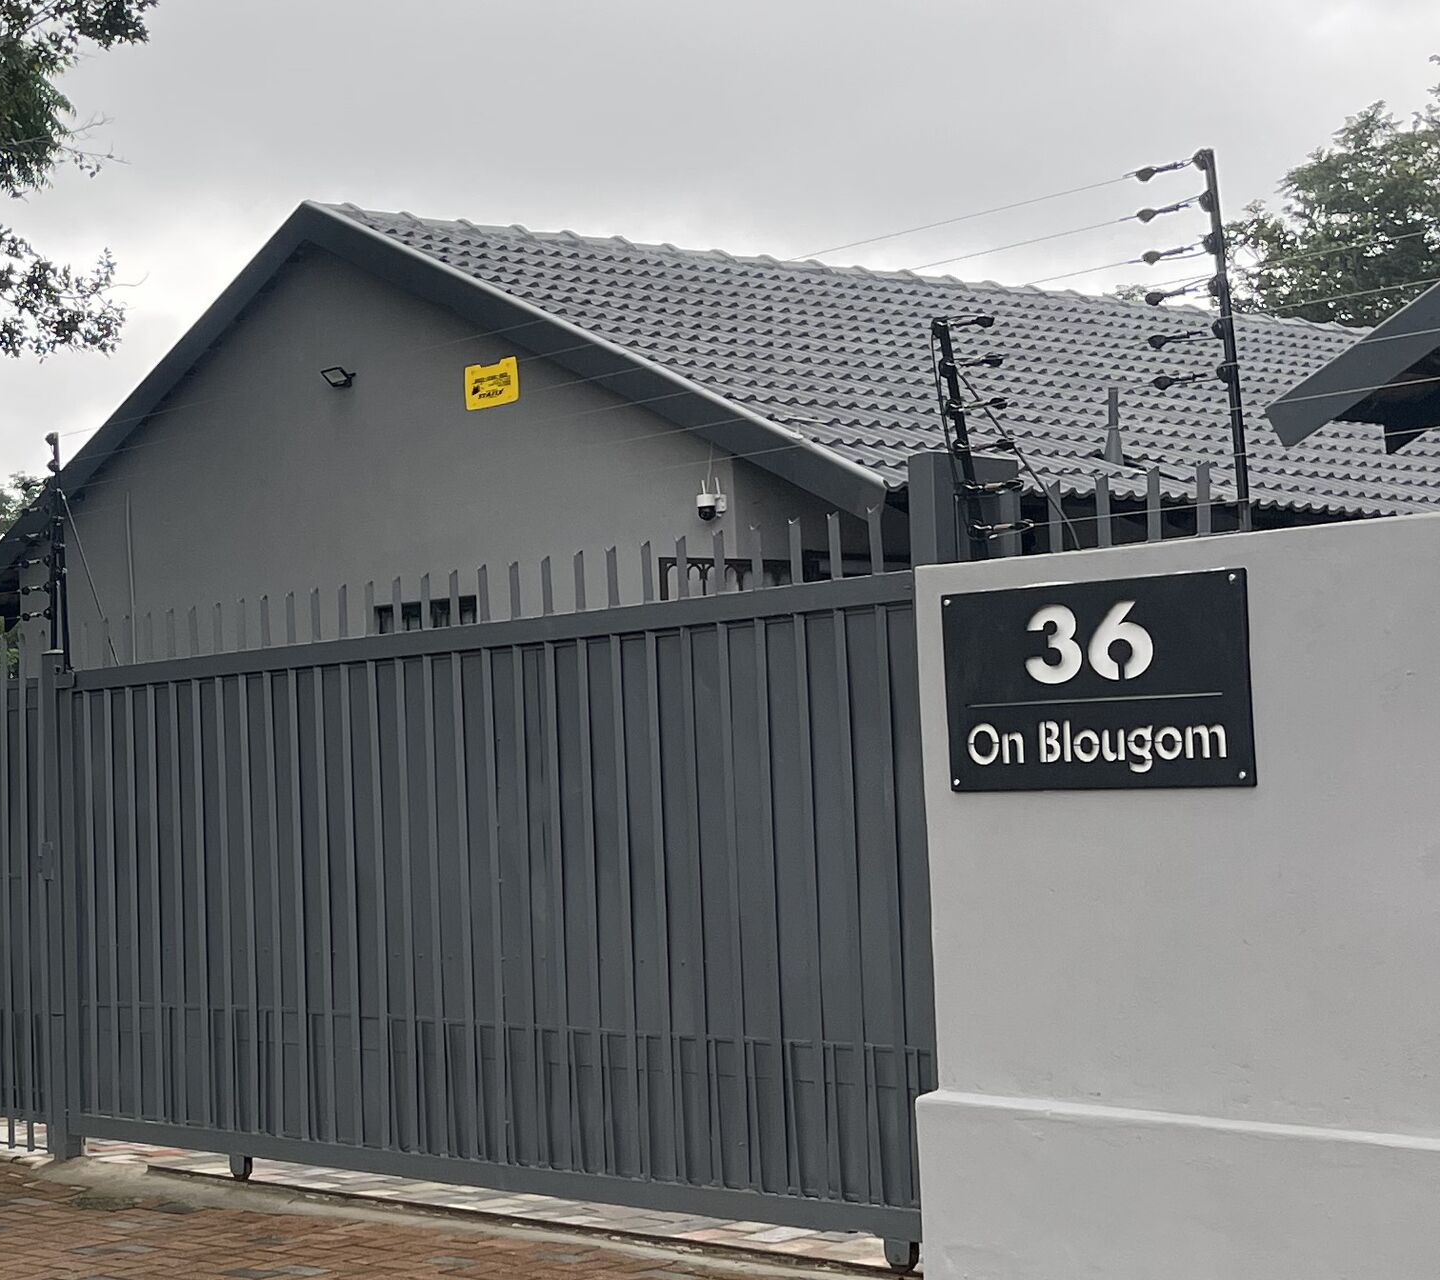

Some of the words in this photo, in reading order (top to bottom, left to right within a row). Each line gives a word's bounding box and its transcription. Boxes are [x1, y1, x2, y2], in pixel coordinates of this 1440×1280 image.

[1025, 600, 1154, 684] 36
[968, 723, 1024, 765] On
[1038, 720, 1228, 773] Blougom
